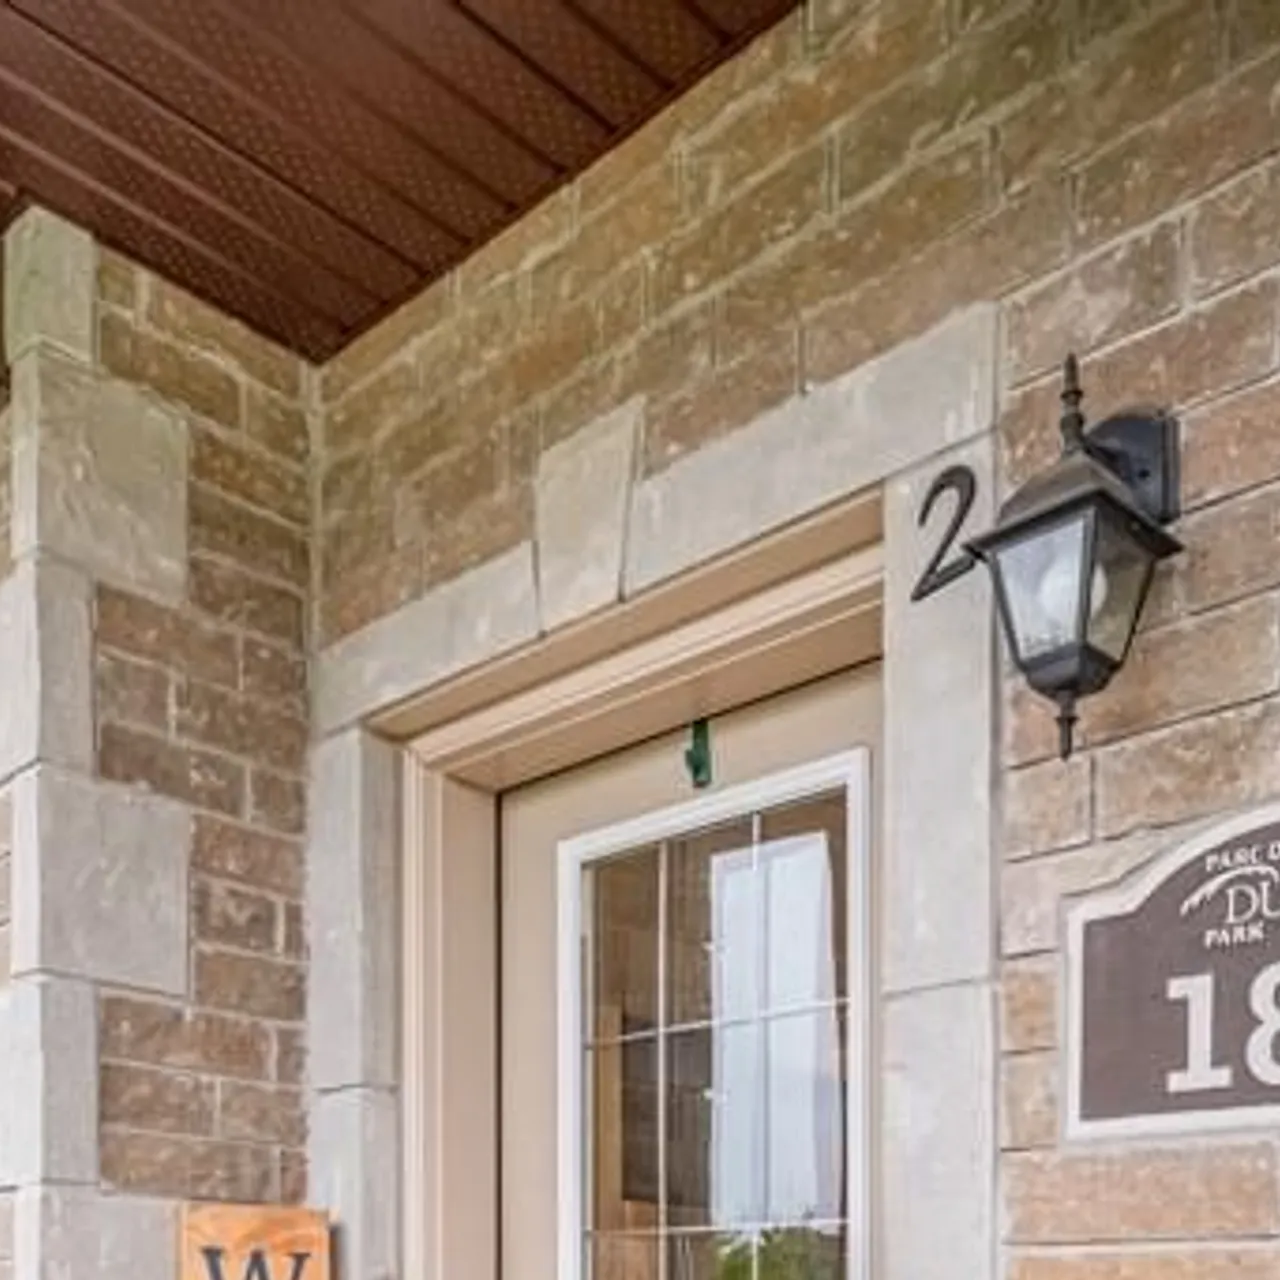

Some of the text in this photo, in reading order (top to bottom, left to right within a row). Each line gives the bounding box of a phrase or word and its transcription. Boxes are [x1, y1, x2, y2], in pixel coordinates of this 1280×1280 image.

[910, 465, 976, 602] 2
[1205, 845, 1259, 872] PARC
[1204, 922, 1265, 949] PARK
